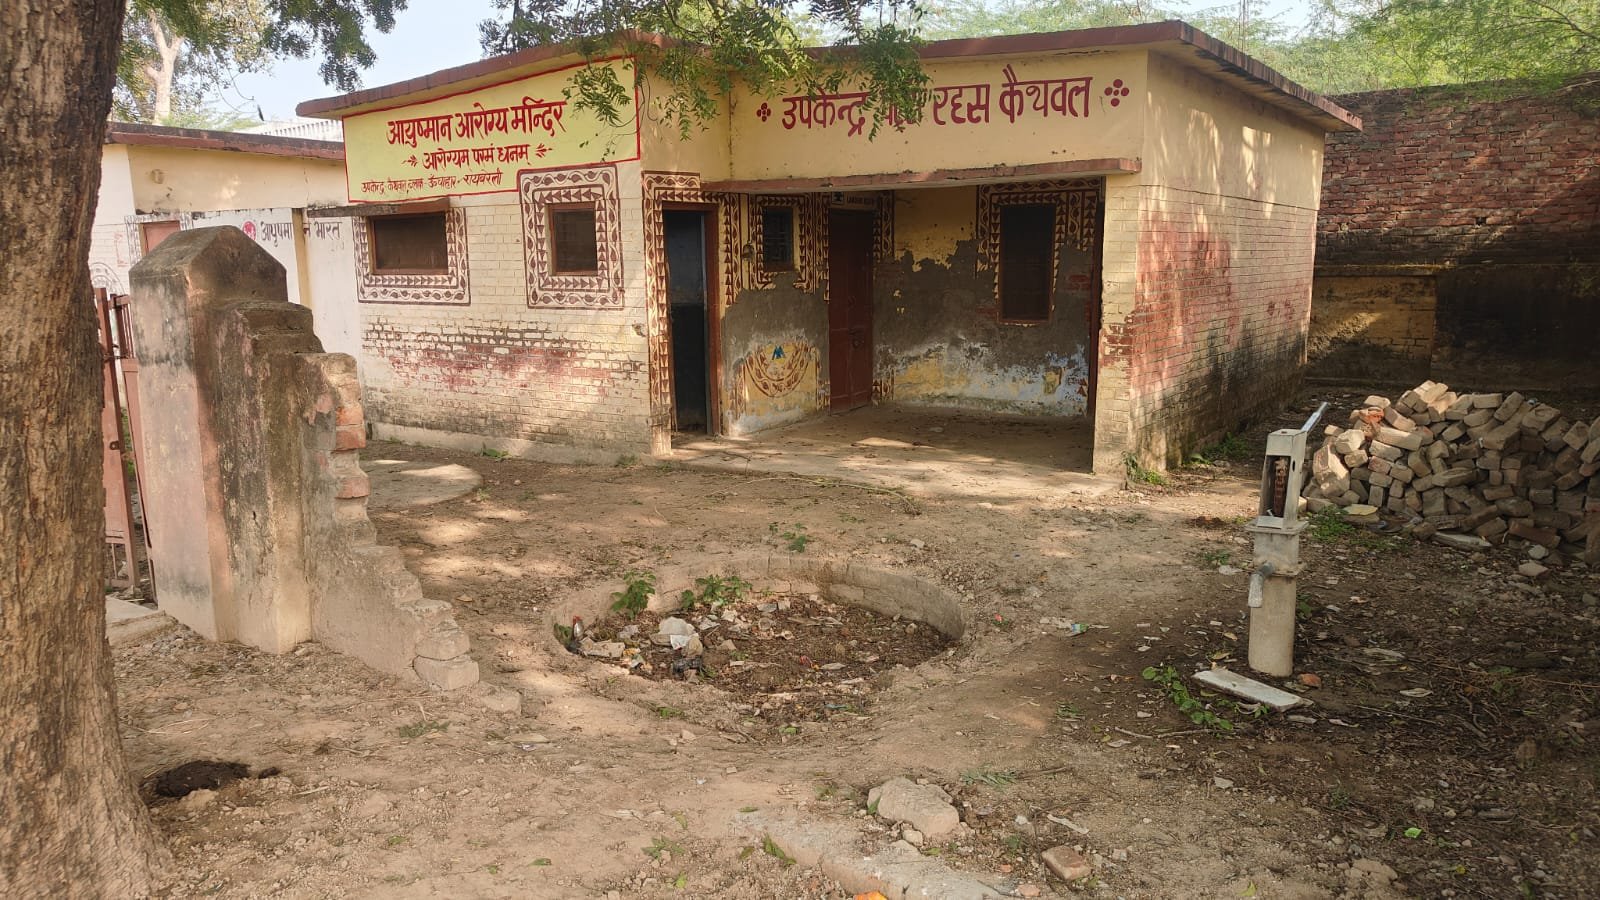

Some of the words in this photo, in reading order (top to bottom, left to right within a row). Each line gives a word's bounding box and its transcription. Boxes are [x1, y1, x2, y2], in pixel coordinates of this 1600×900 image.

[387, 114, 454, 148] आयुष्मान
[455, 102, 509, 140] आरोग्य
[511, 96, 567, 137] मन्दिर
[782, 86, 872, 137] उपकेन्द्र
[999, 63, 1093, 124] कैथवल
[314, 221, 343, 241] भारत
